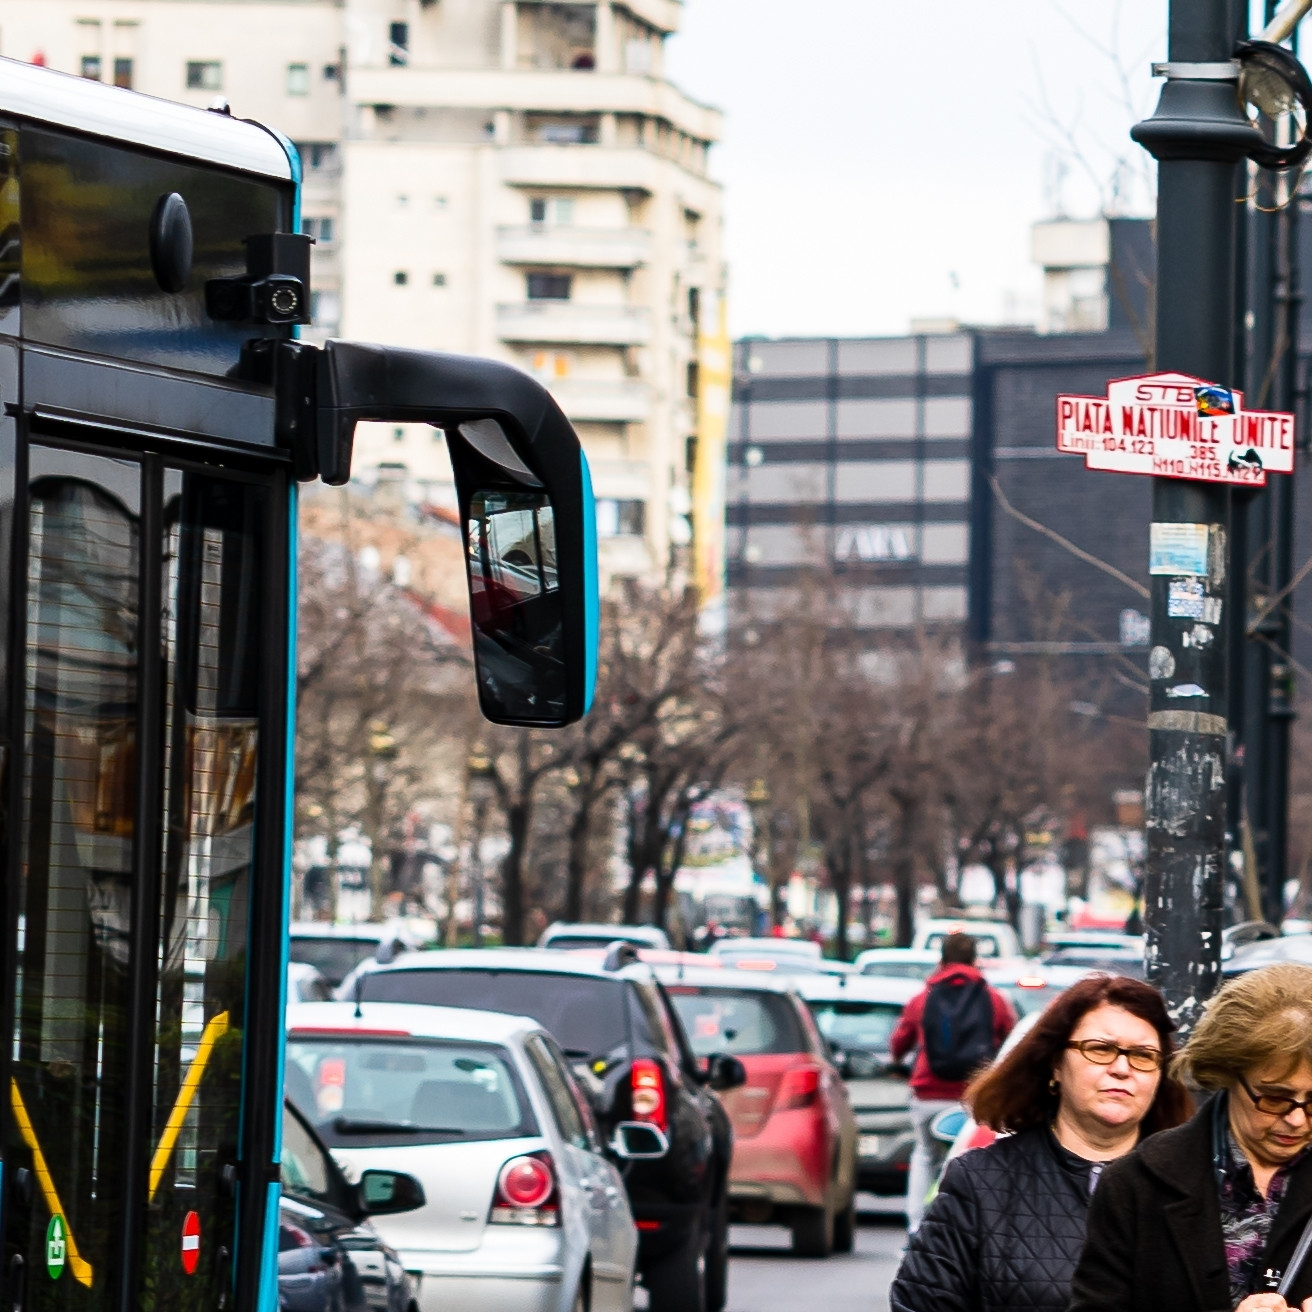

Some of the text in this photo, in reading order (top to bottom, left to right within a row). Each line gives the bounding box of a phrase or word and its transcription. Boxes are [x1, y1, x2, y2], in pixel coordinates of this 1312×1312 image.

[1135, 385, 1195, 402] STB
[1061, 400, 1290, 450] PIATA NATIUNILE UNITE
